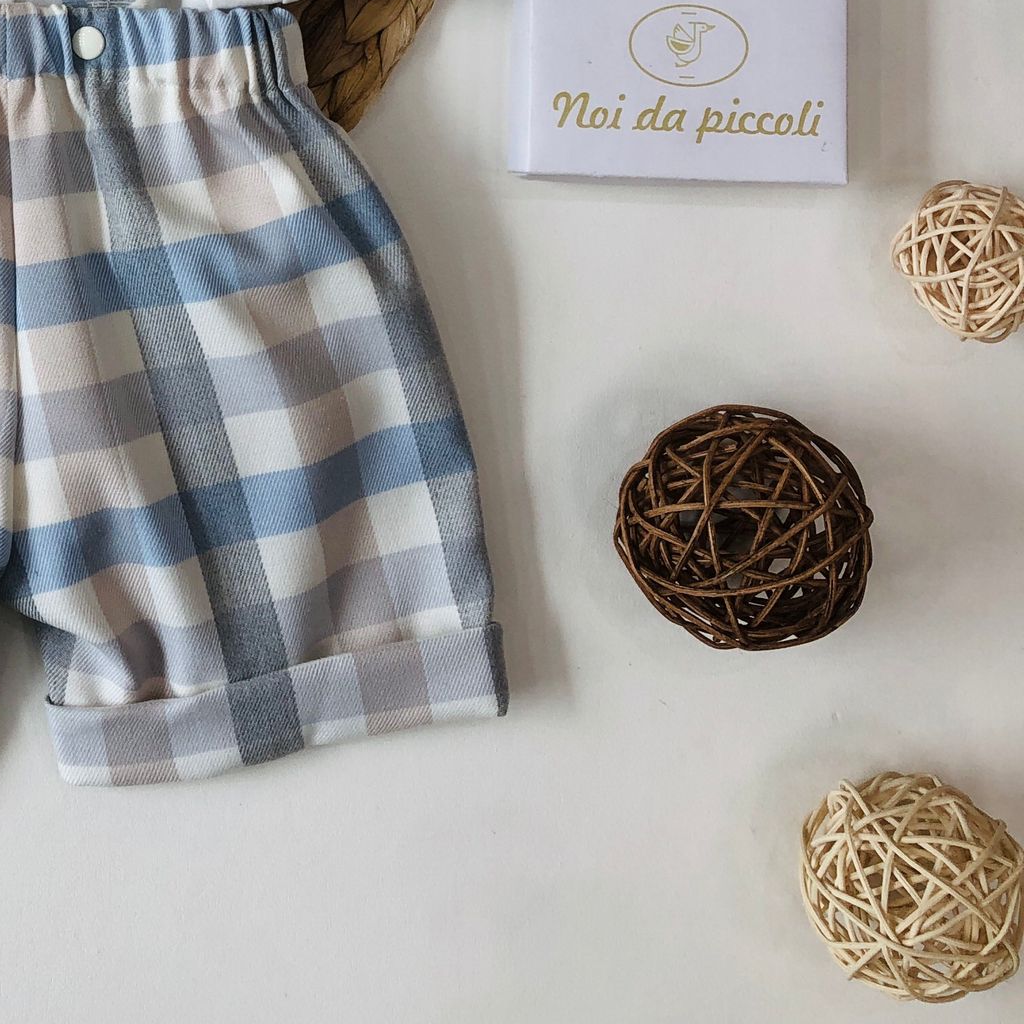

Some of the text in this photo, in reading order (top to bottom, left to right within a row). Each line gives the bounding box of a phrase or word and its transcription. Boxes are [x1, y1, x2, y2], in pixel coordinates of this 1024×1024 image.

[552, 91, 825, 144] Noi da piccoli
